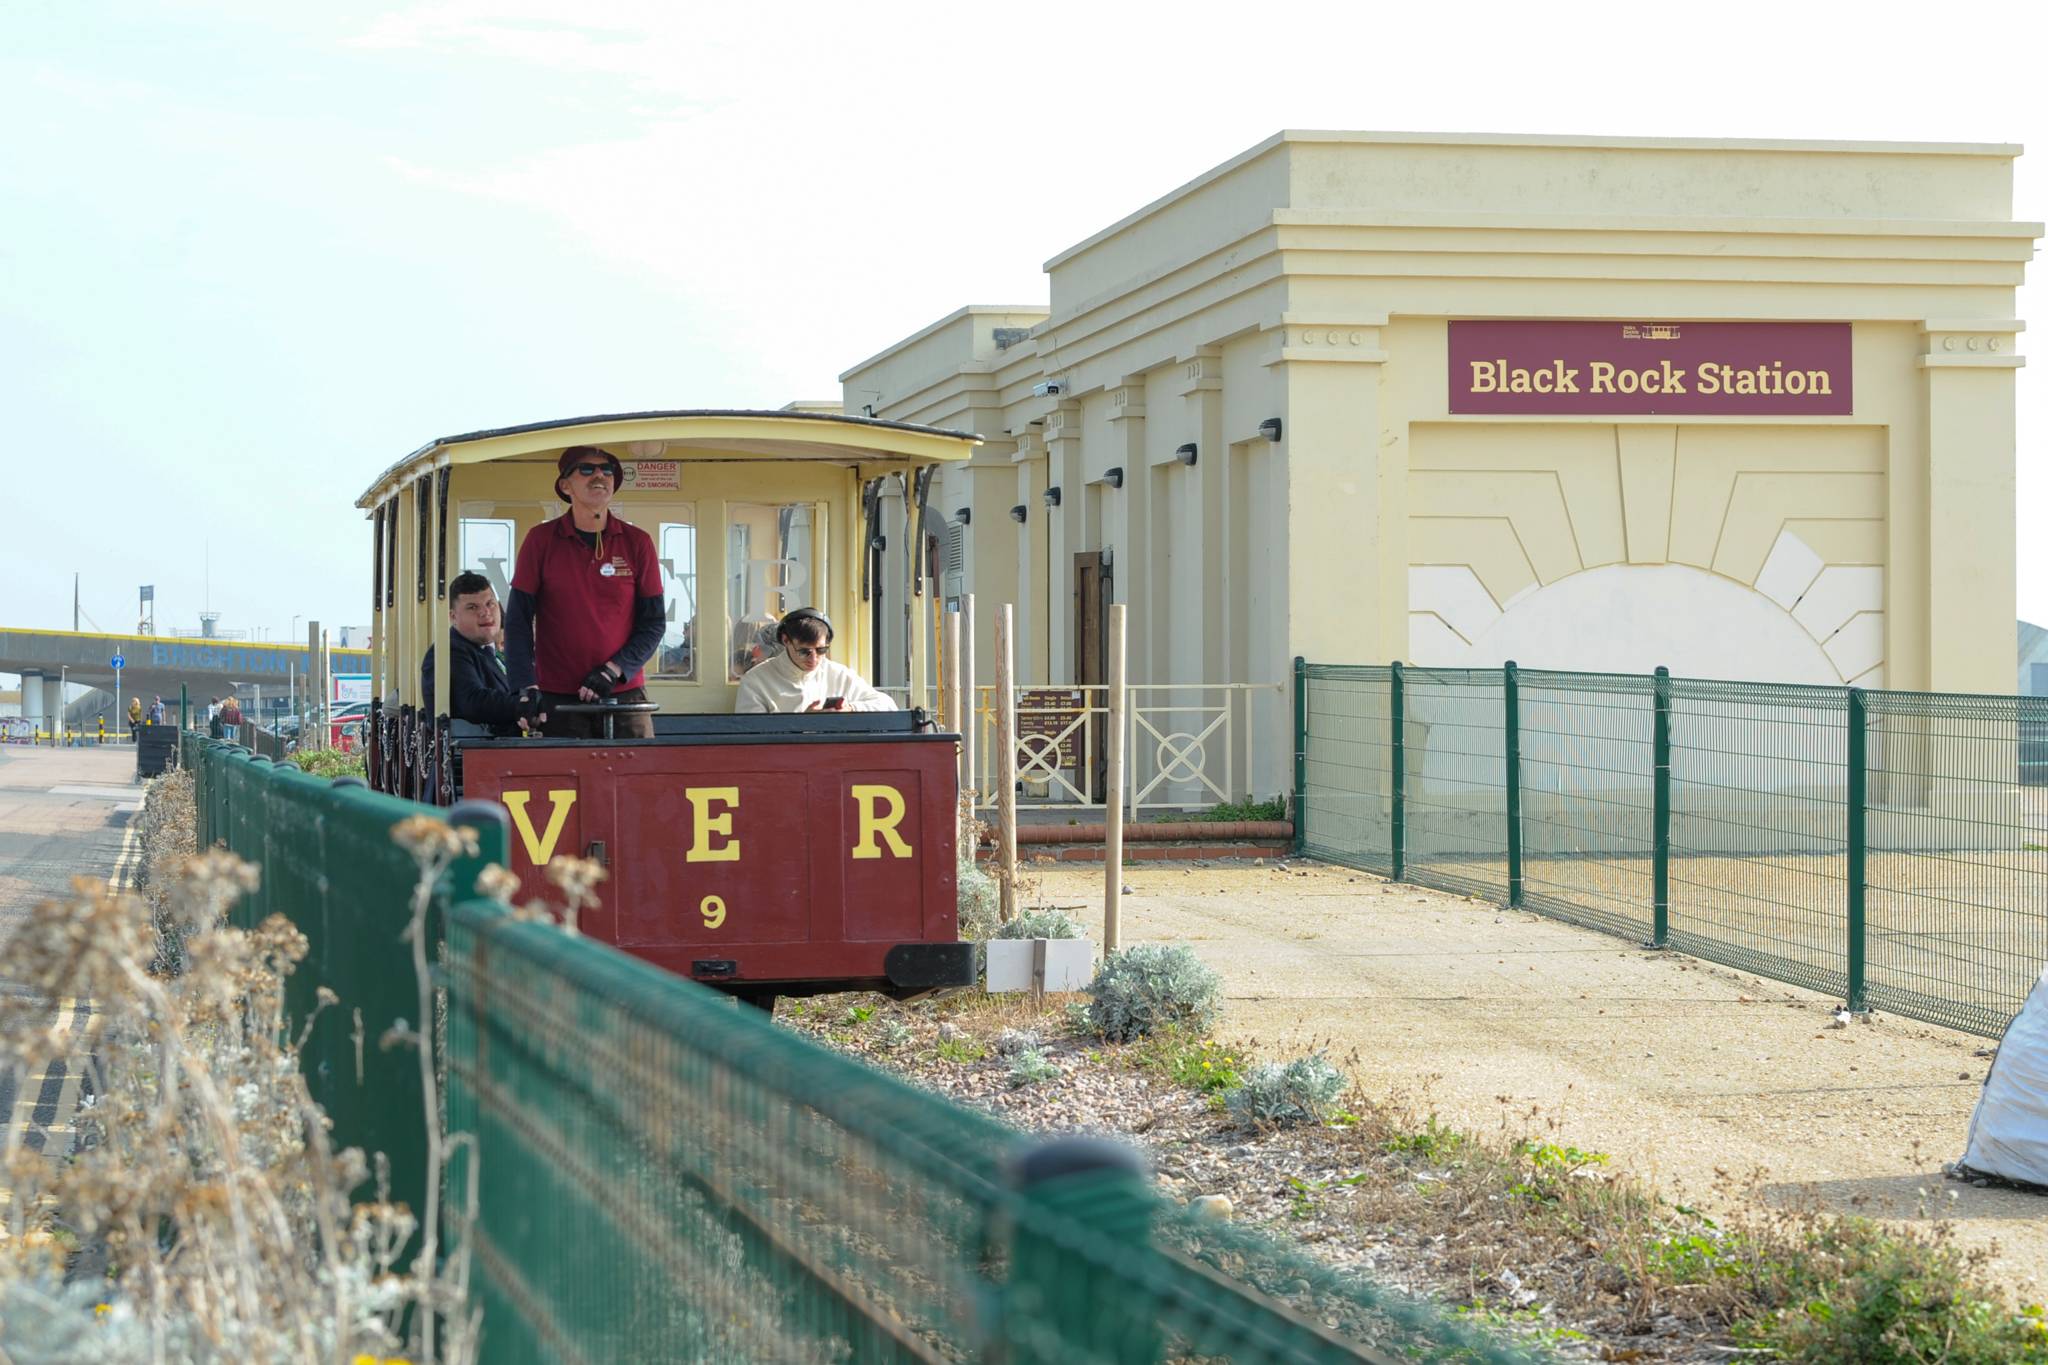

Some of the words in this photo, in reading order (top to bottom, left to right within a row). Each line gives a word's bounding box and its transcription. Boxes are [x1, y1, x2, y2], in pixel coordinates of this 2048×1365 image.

[1470, 359, 1580, 393] Black
[1590, 360, 1686, 394] Rock
[1697, 361, 1832, 395] Station
[152, 644, 287, 673] BRIGHTON
[502, 790, 577, 865] V
[685, 786, 740, 862] E
[851, 784, 913, 859] R
[700, 895, 727, 929] 9
